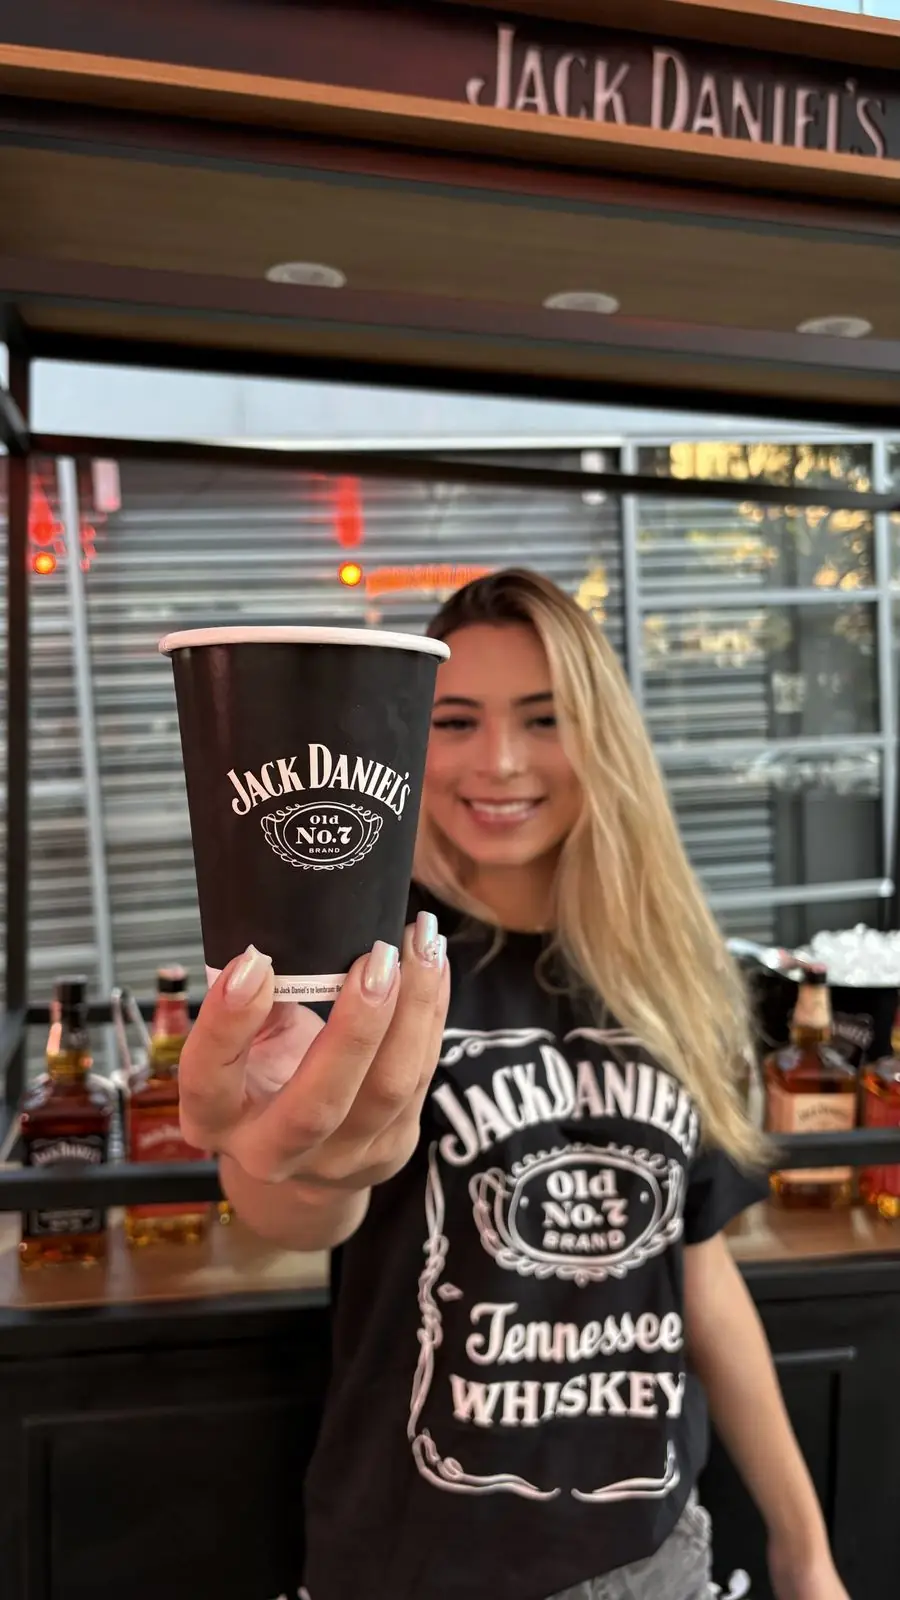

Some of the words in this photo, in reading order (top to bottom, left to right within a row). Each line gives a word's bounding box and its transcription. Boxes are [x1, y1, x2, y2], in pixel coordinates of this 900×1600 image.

[466, 23, 630, 125] JACK
[227, 756, 305, 815] JACK
[308, 743, 411, 816] DANIEL'S
[295, 826, 353, 845] No.7
[309, 814, 339, 825] Old
[432, 1062, 552, 1166] JACK
[539, 1044, 700, 1158] DANIELS
[546, 1169, 618, 1200] Old
[543, 1229, 627, 1251] BRAND
[465, 1302, 684, 1365] Tennessee
[449, 1371, 686, 1428] WHISKEY
